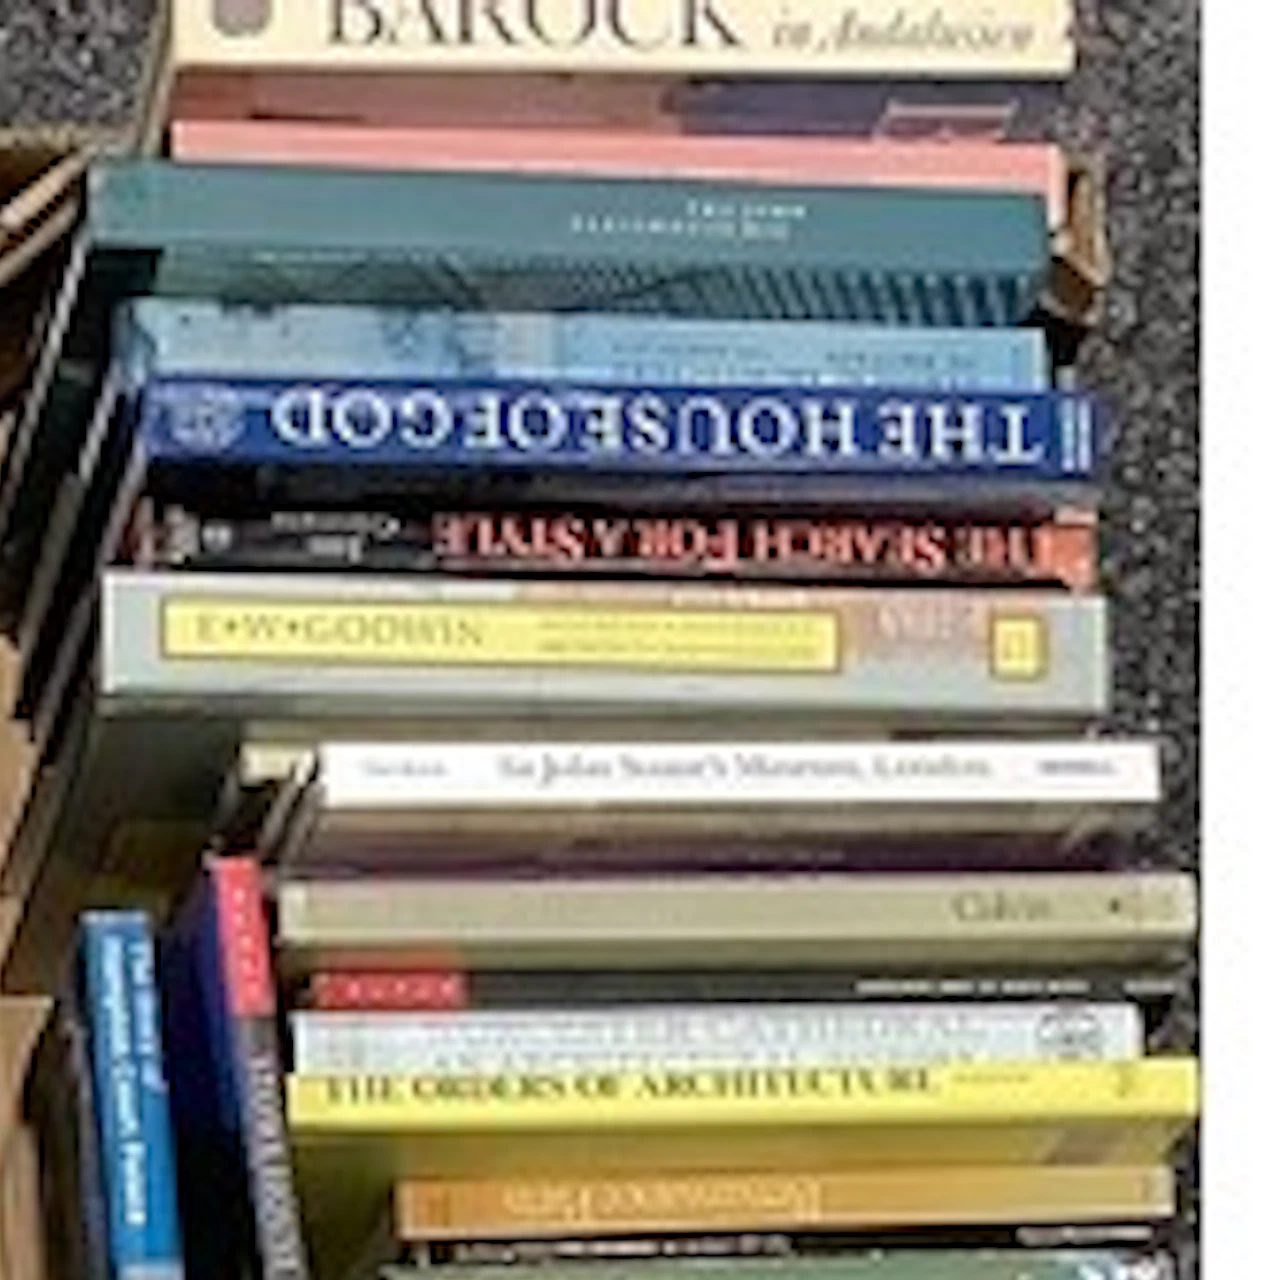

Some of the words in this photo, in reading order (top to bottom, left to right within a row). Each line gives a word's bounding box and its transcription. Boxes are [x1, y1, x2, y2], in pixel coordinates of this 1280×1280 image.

[326, 0, 746, 48] BAROCK
[268, 391, 453, 454] GOD
[462, 396, 565, 454] OF
[585, 400, 855, 460] HOUSE
[876, 403, 1036, 464] THE
[432, 517, 586, 564] STYLE
[635, 524, 740, 569] FOR
[755, 525, 947, 569] SEARCH
[324, 1074, 392, 1105] THE
[410, 1072, 566, 1104] ORDERS
[572, 1070, 616, 1101] OF
[640, 1064, 934, 1101] ARCHITECTURE
